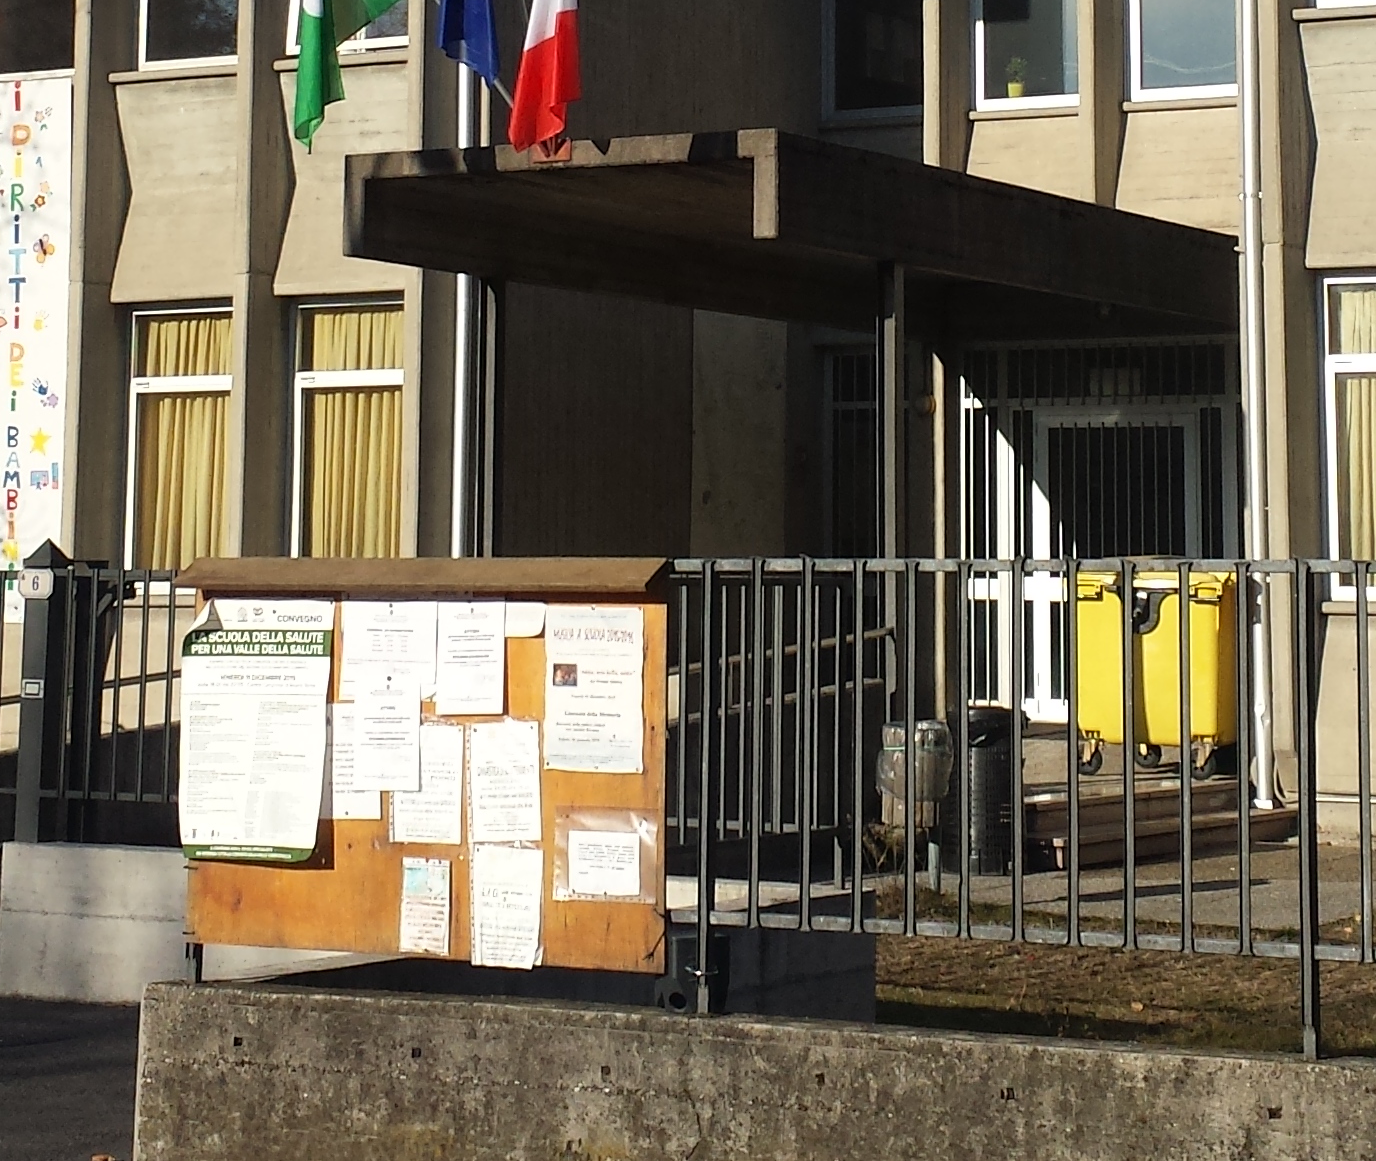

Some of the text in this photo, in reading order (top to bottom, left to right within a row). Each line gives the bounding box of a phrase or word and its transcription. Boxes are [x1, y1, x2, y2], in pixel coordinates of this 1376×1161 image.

[31, 575, 40, 591] 6
[276, 615, 323, 623] CONVEGNO
[208, 631, 252, 643] SCUOLA
[252, 631, 284, 643] DELLA
[285, 631, 324, 643] SALUTE
[191, 644, 324, 655] PER UNA VALLE DELLA SALUTE
